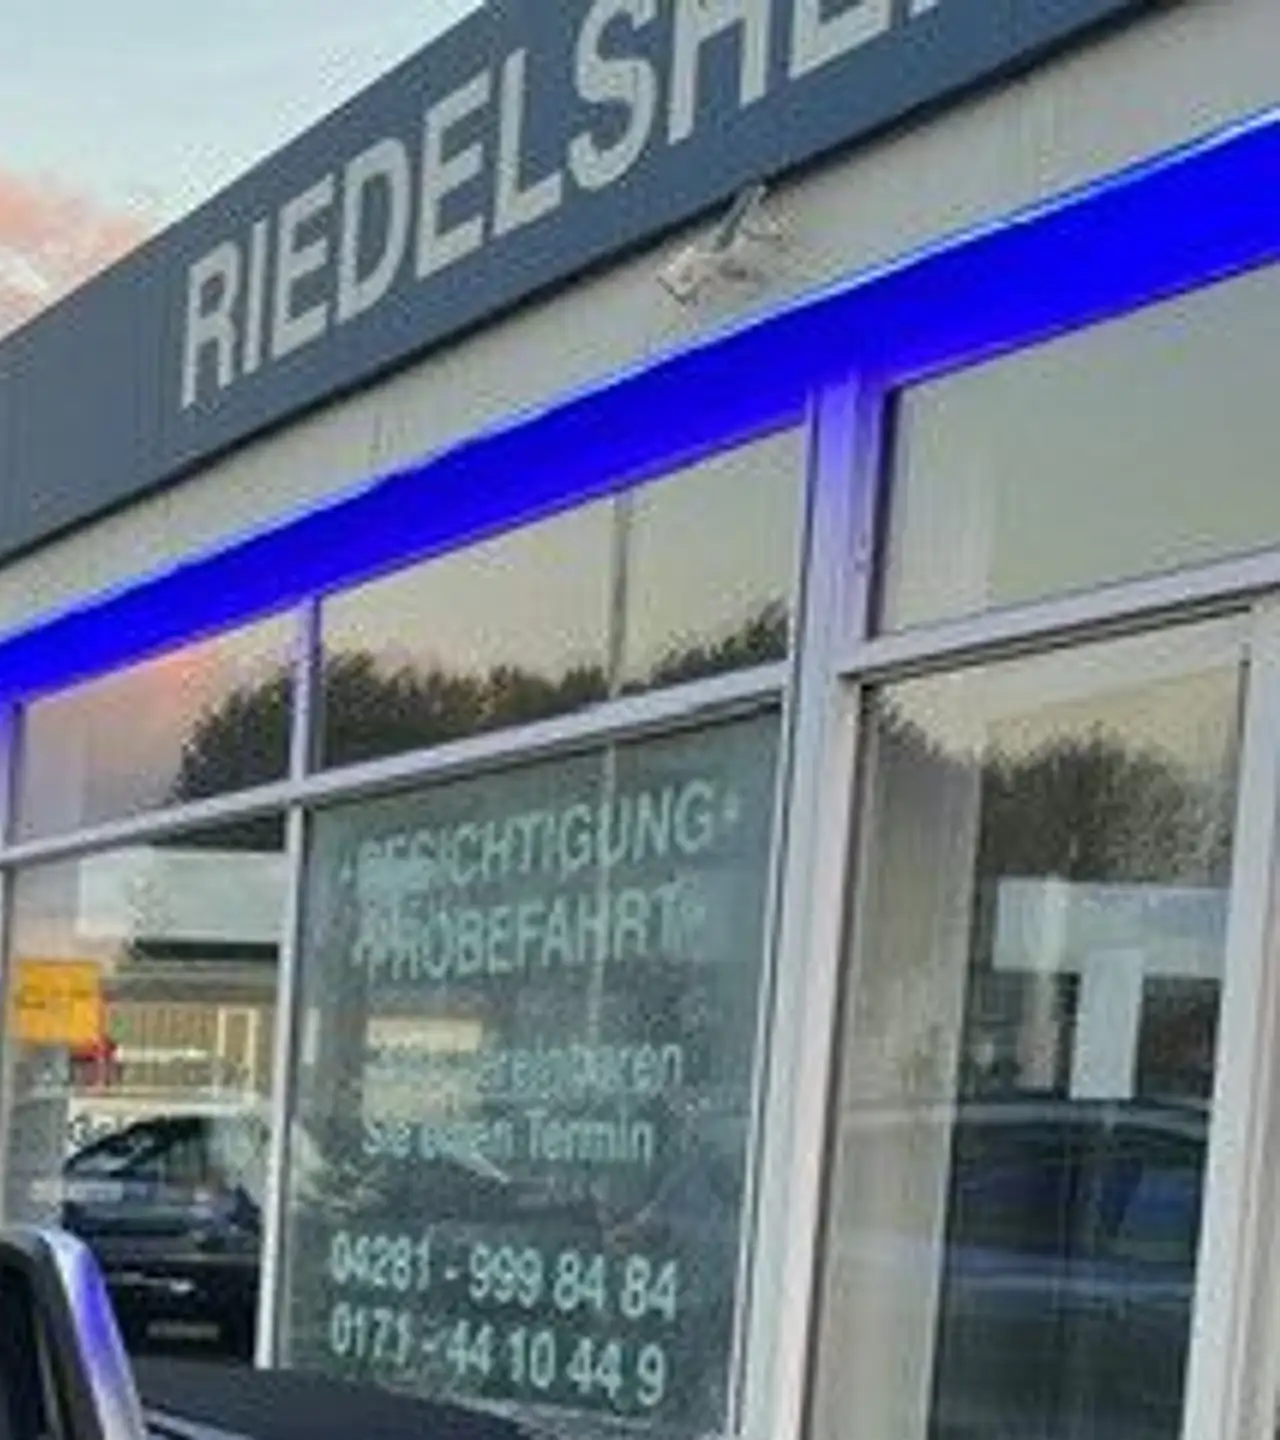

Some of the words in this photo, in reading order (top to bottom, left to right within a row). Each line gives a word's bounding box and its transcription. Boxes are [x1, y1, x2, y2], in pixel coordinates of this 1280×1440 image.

[178, 0, 937, 408] RIEDELSH
[526, 1104, 656, 1168] Termin
[330, 1230, 433, 1292] 04281
[468, 1242, 543, 1309] 999
[554, 1249, 607, 1311] 84
[619, 1254, 680, 1322] 84
[446, 1319, 496, 1376] 44
[507, 1325, 556, 1389] 10
[565, 1336, 622, 1400] 44
[636, 1342, 666, 1406] 9
